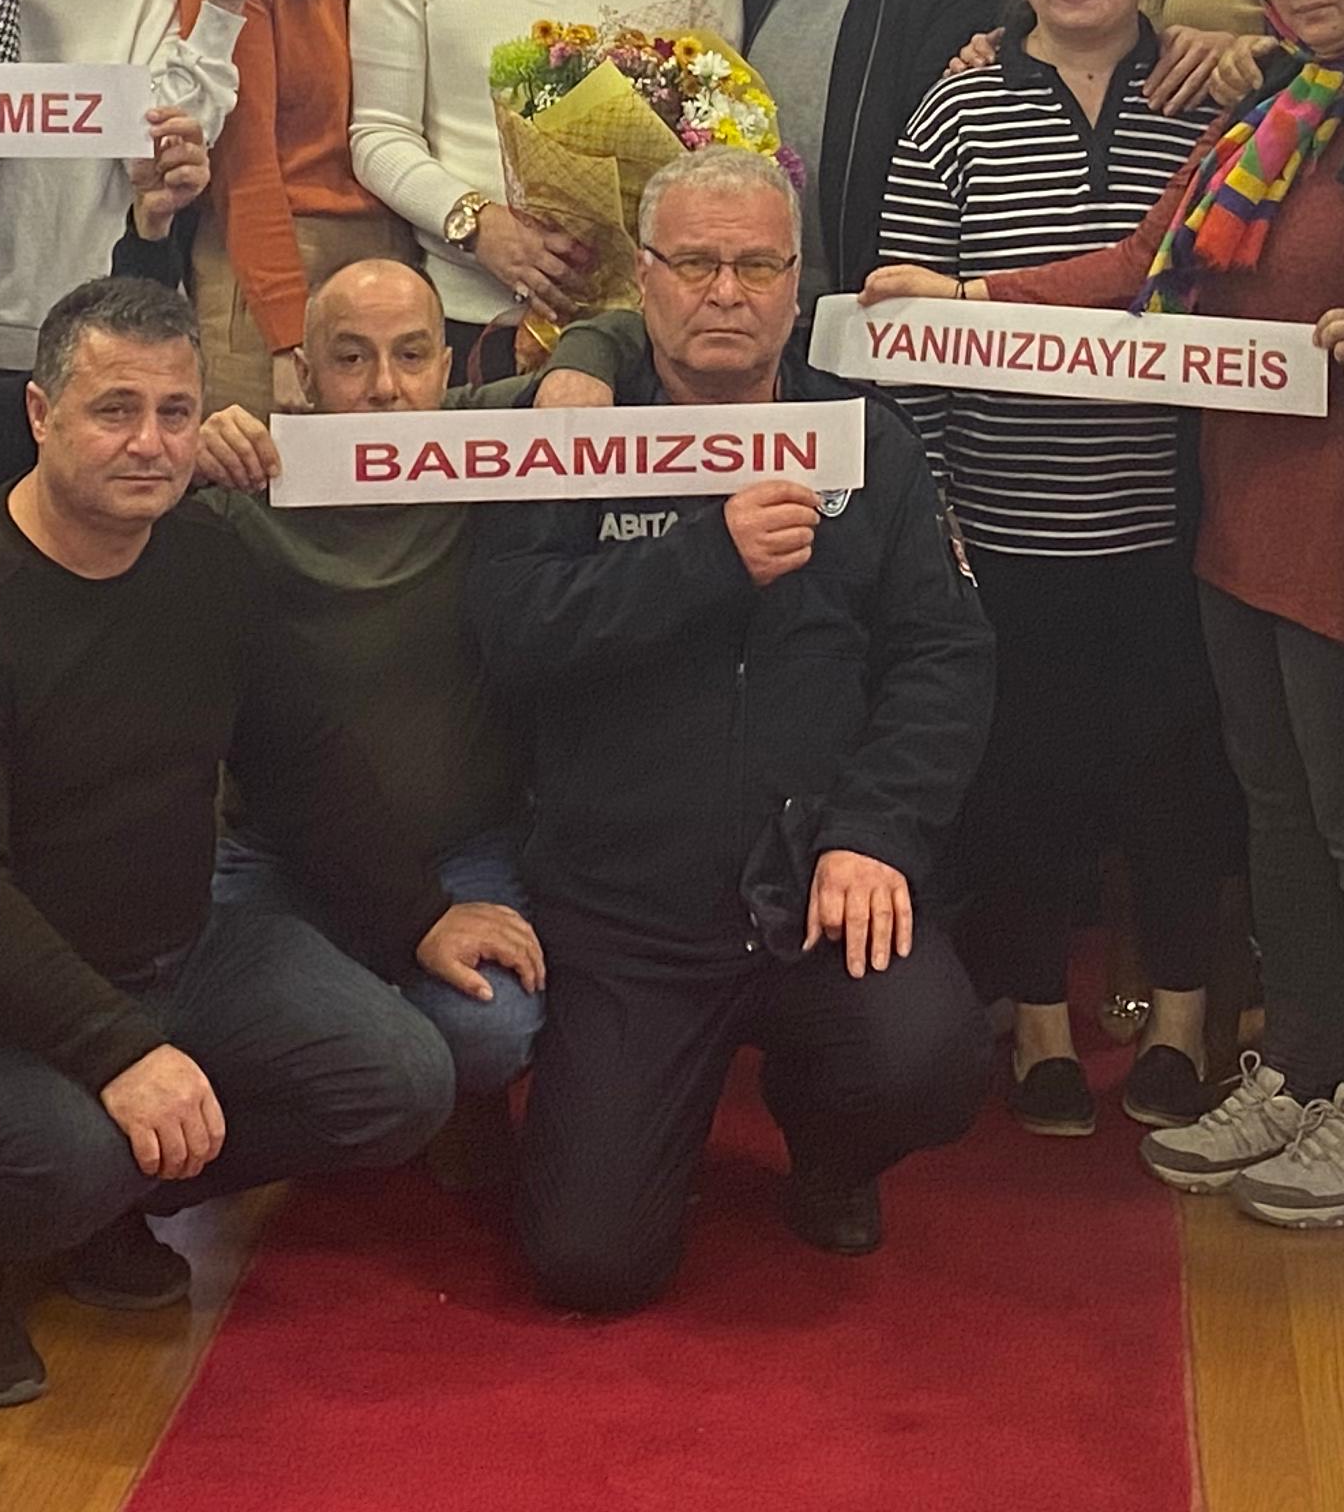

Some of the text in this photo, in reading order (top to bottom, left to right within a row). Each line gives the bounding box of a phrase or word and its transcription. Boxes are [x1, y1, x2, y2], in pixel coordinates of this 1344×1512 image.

[866, 321, 1288, 391] YANINIZDAYIZ REİS
[355, 431, 818, 483] BABAMIZSIN
